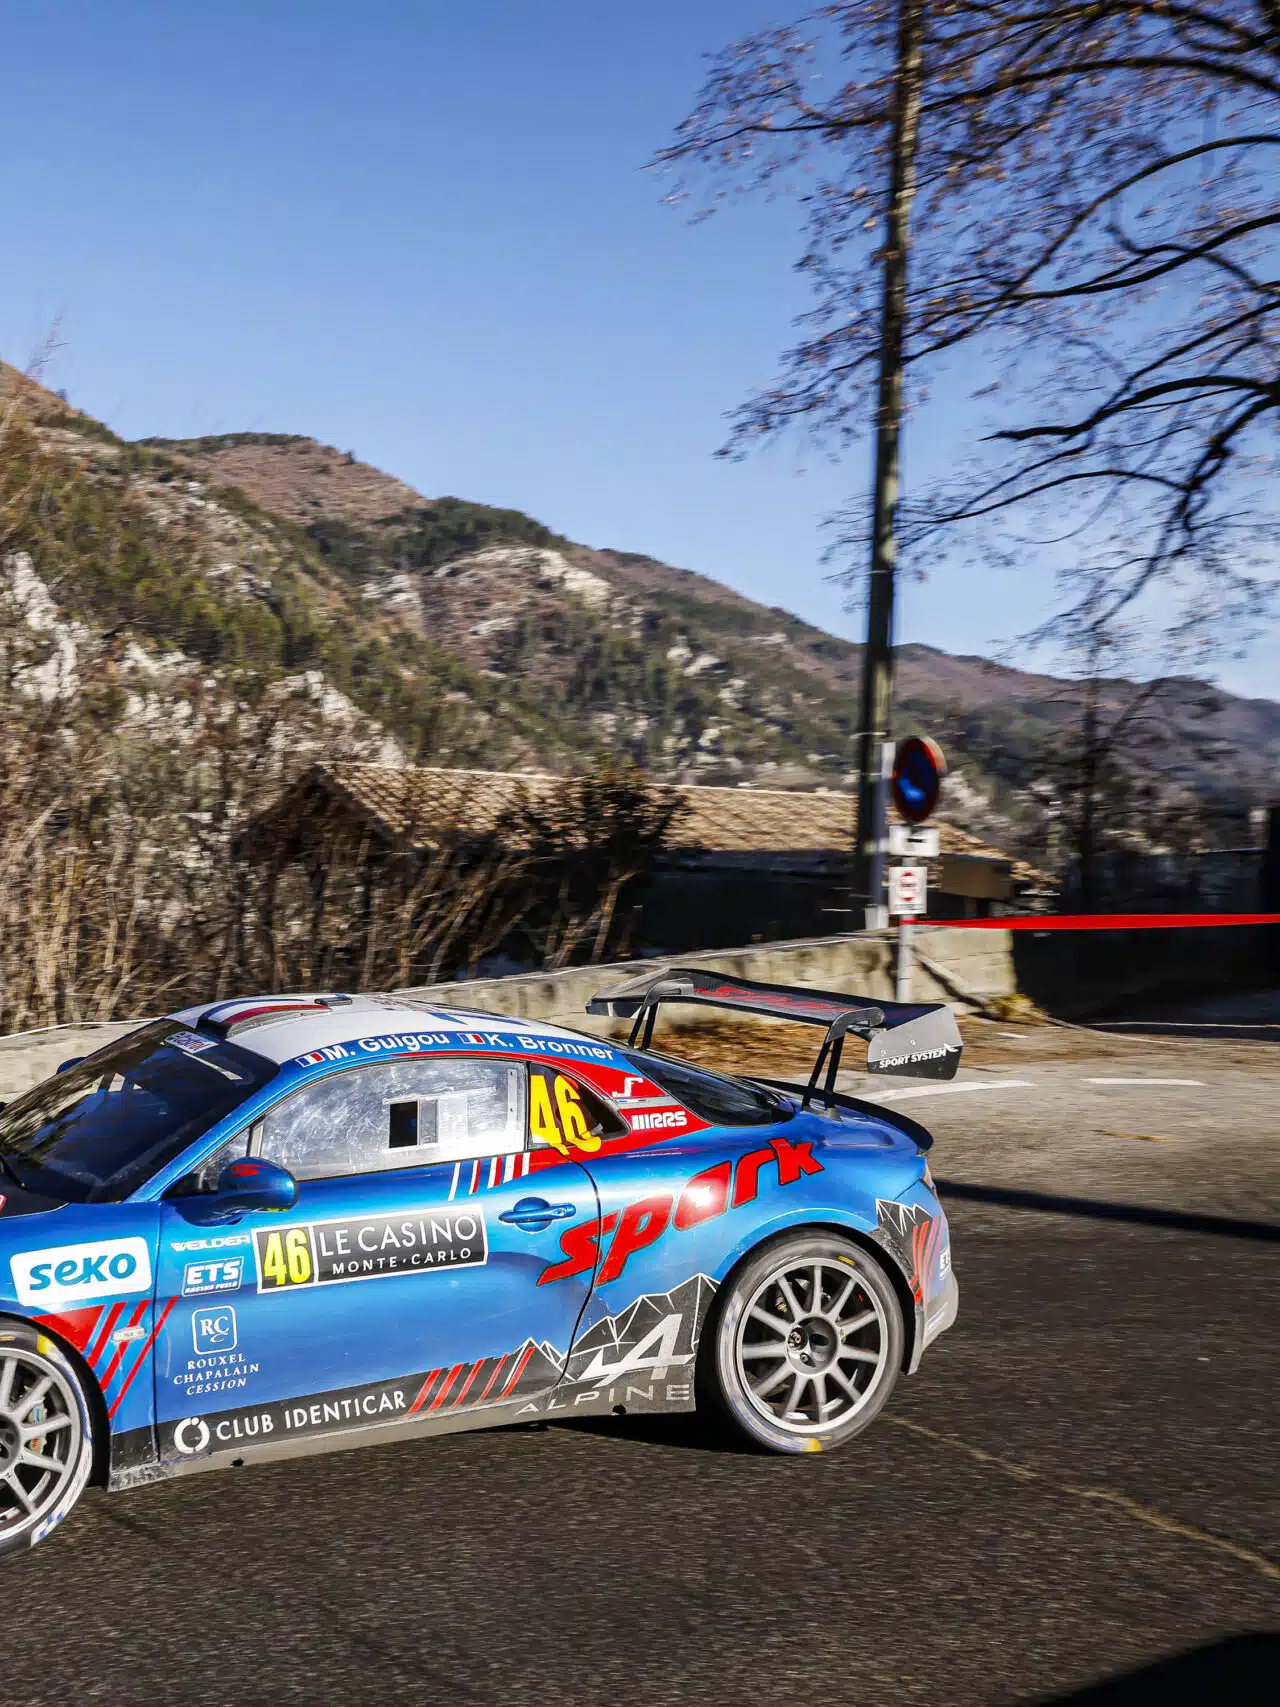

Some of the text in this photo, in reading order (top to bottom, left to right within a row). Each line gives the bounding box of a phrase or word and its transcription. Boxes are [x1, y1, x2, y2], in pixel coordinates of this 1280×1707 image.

[325, 1032, 449, 1060] M. Guigou
[488, 1033, 615, 1061] K. Bronner
[879, 1047, 947, 1069] SPORT SYSTEM
[530, 1074, 603, 1155] 46
[263, 1215, 477, 1286] 46 LE CASINO
[187, 1260, 241, 1285] ETS
[173, 1363, 260, 1385] CHAPALAIN
[187, 1353, 246, 1370] ROUXEL
[186, 1378, 247, 1395] CESSION
[513, 1384, 690, 1416] ALPINE
[216, 1390, 407, 1441] CLUB IDENTICAR
